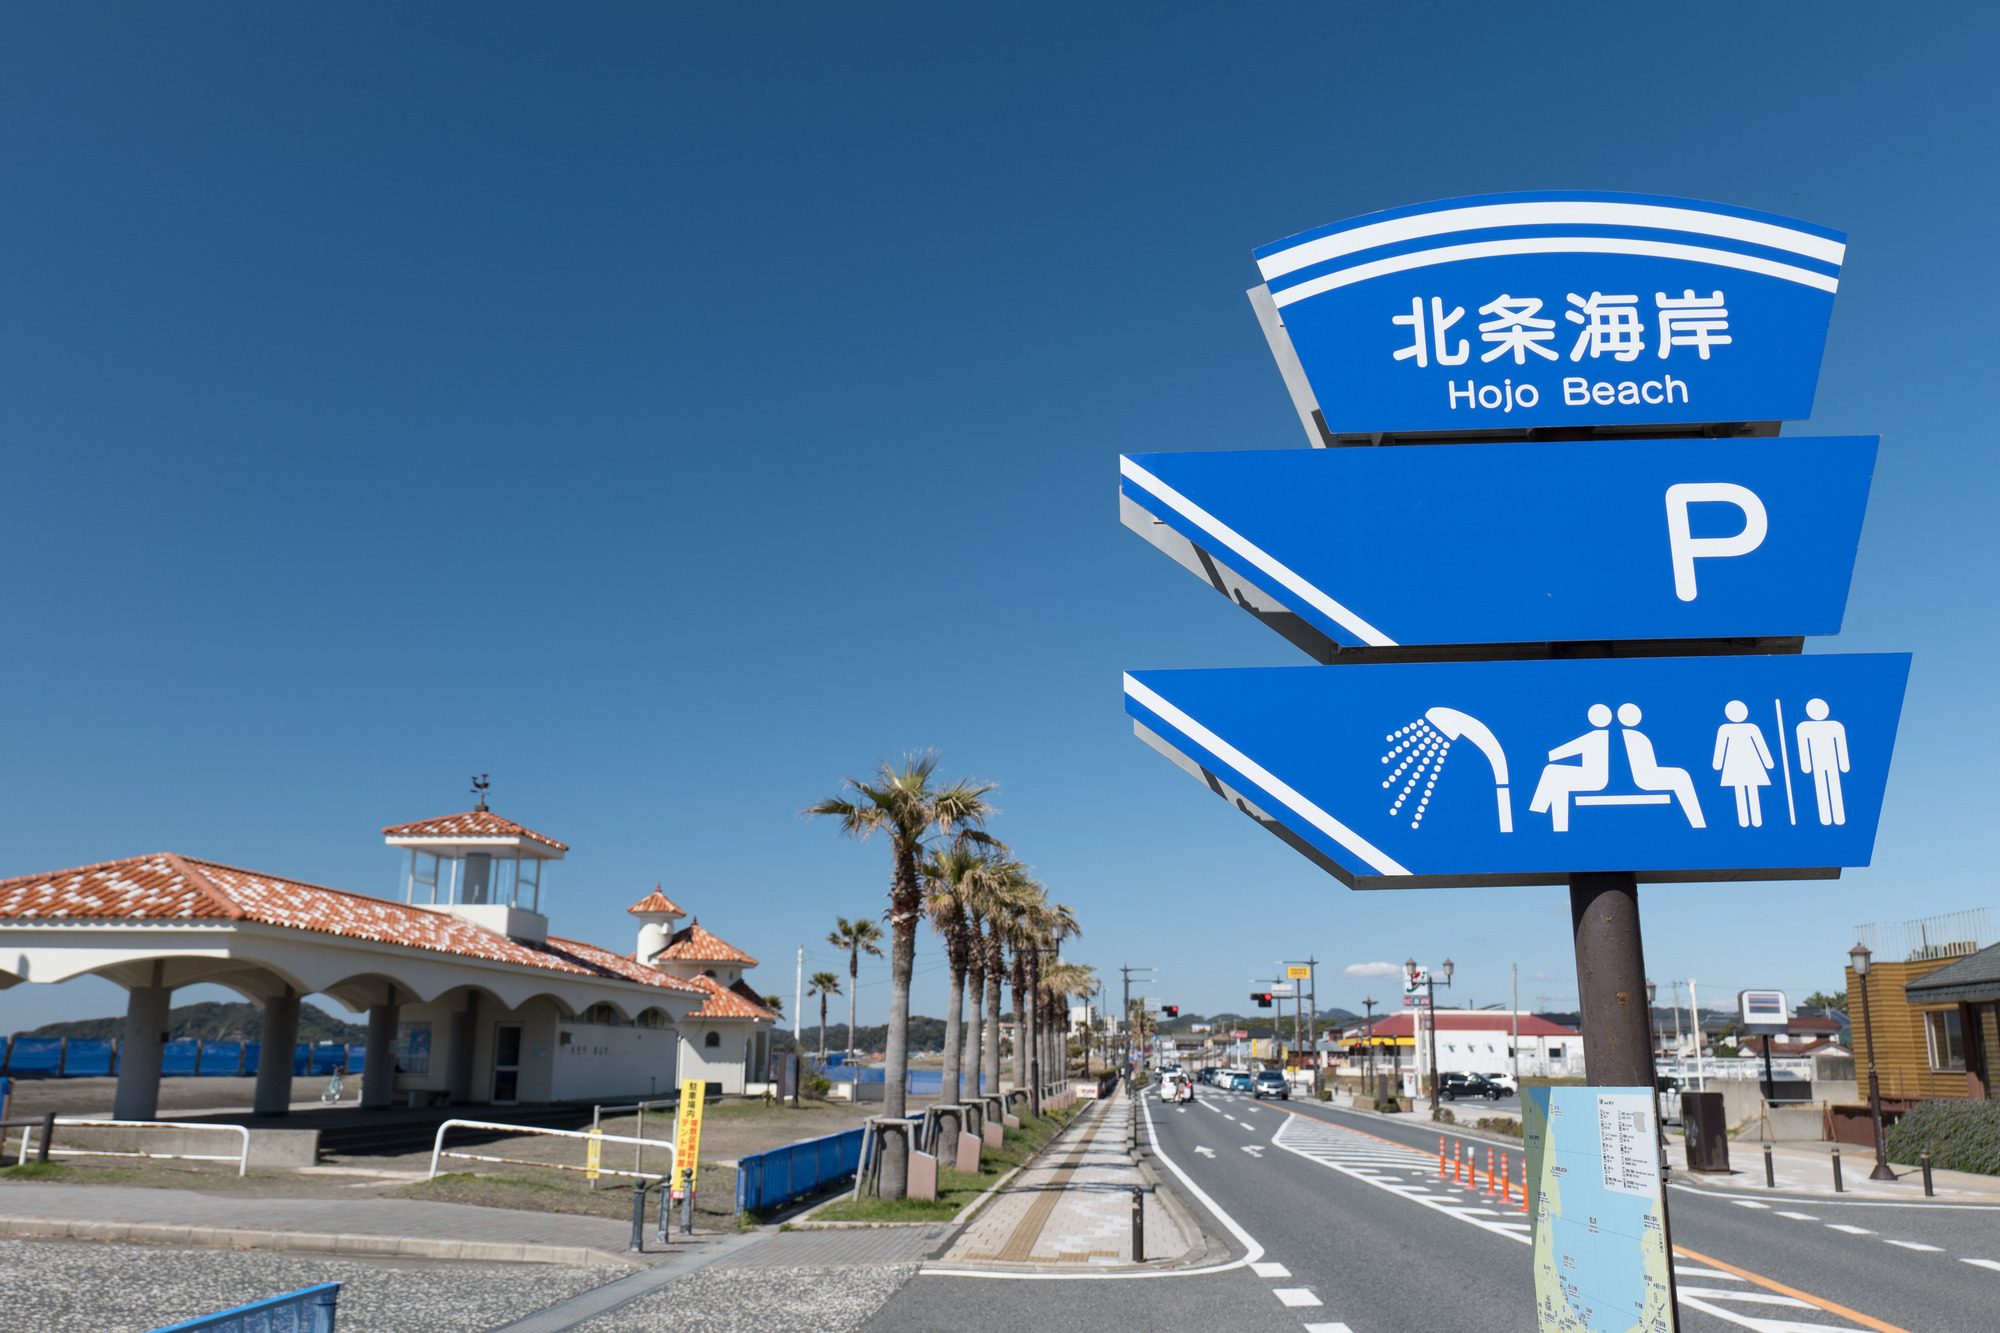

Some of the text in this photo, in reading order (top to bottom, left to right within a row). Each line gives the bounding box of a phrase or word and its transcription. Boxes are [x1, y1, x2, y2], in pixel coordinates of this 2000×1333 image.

[1391, 288, 1733, 368] 北条海岸
[1448, 374, 1689, 413] Hojo Beach
[1664, 482, 1768, 602] P
[686, 1082, 697, 1118] 駐車場内
[678, 1119, 688, 1167] テント設置
